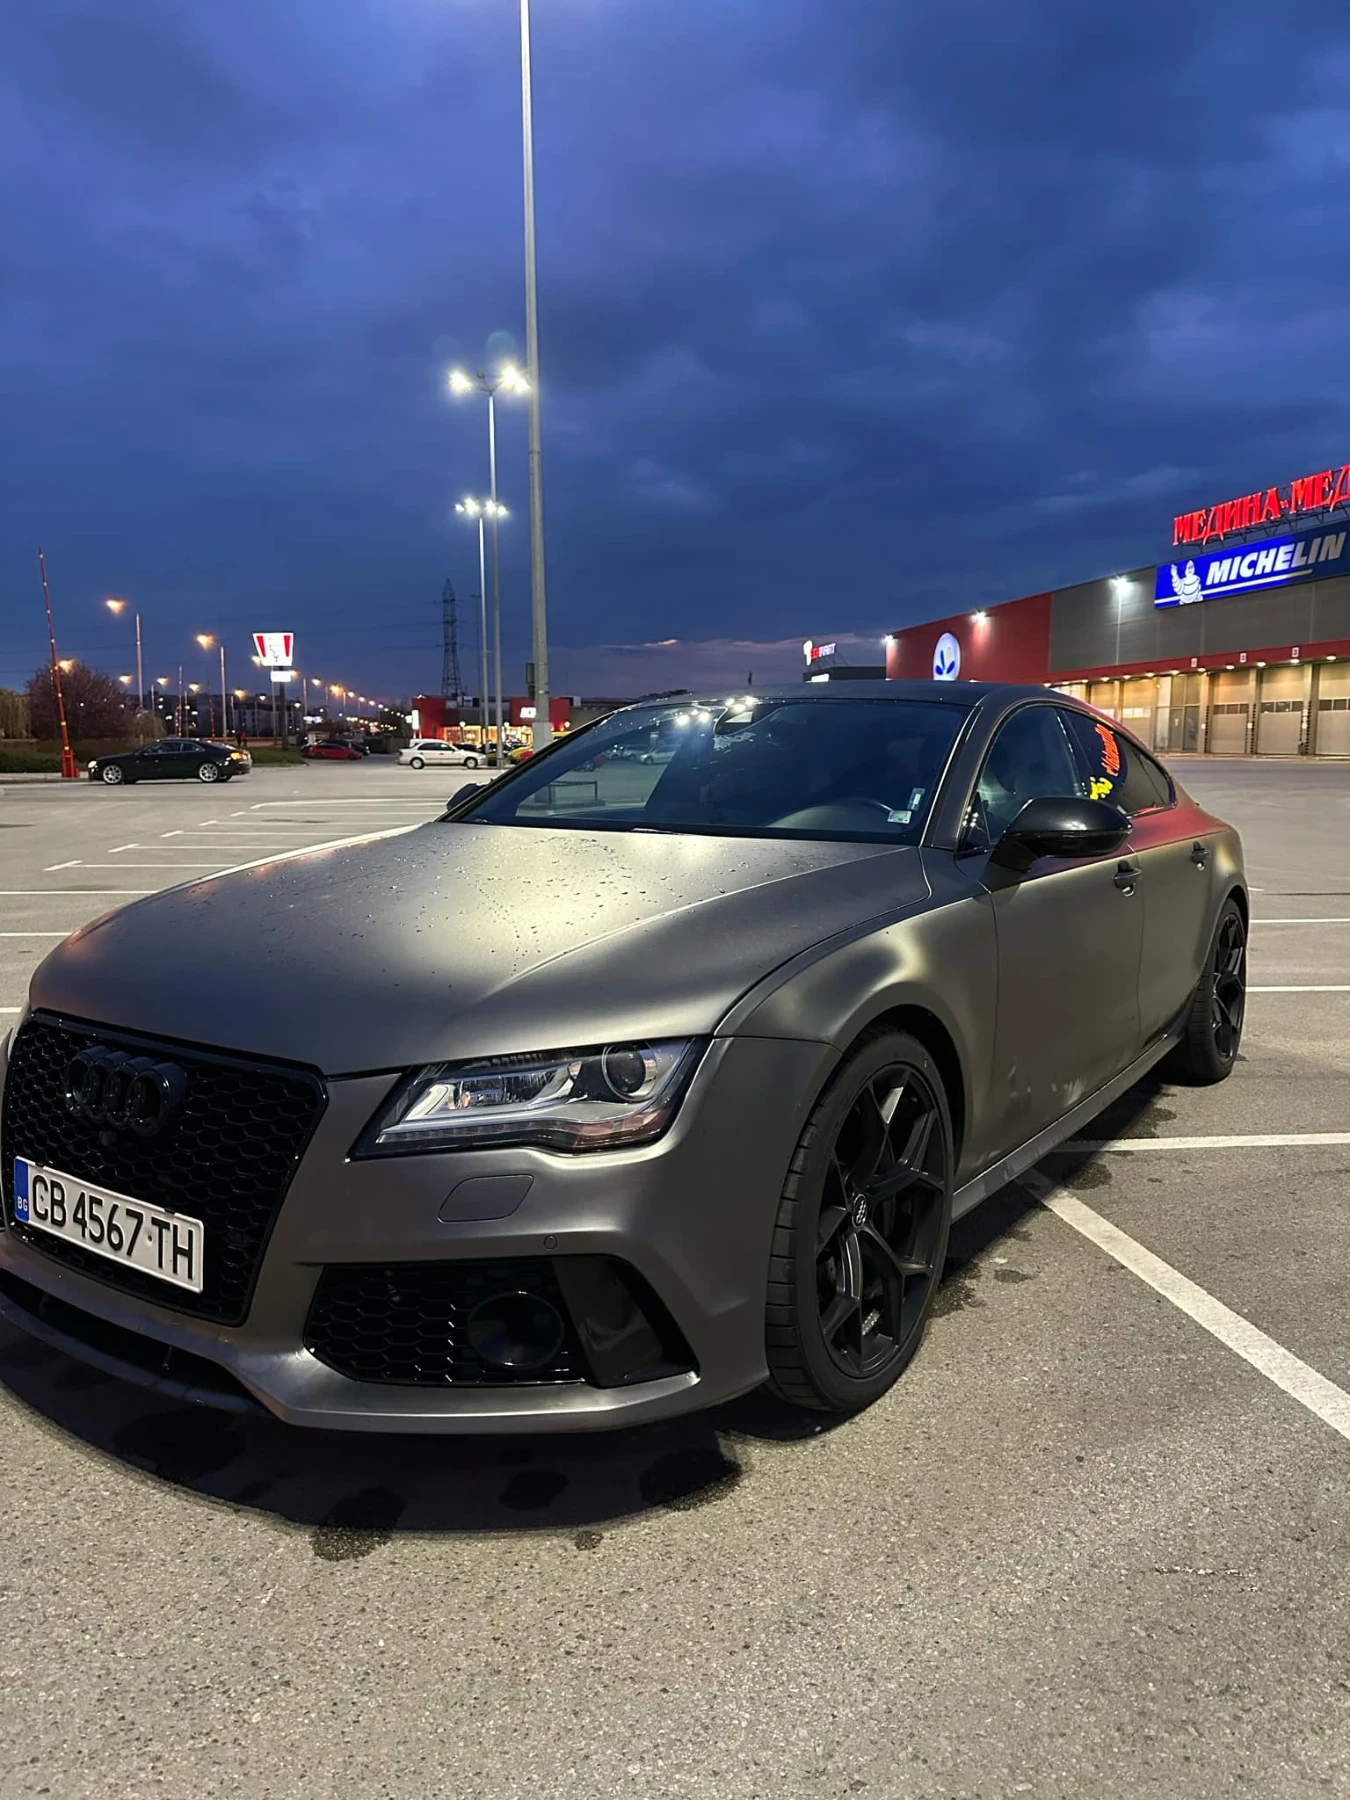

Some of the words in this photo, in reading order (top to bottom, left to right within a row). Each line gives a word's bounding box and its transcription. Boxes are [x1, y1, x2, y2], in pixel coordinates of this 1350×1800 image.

[1206, 532, 1346, 585] MICHELIN
[17, 1196, 28, 1212] BG
[72, 1191, 143, 1258] 4567
